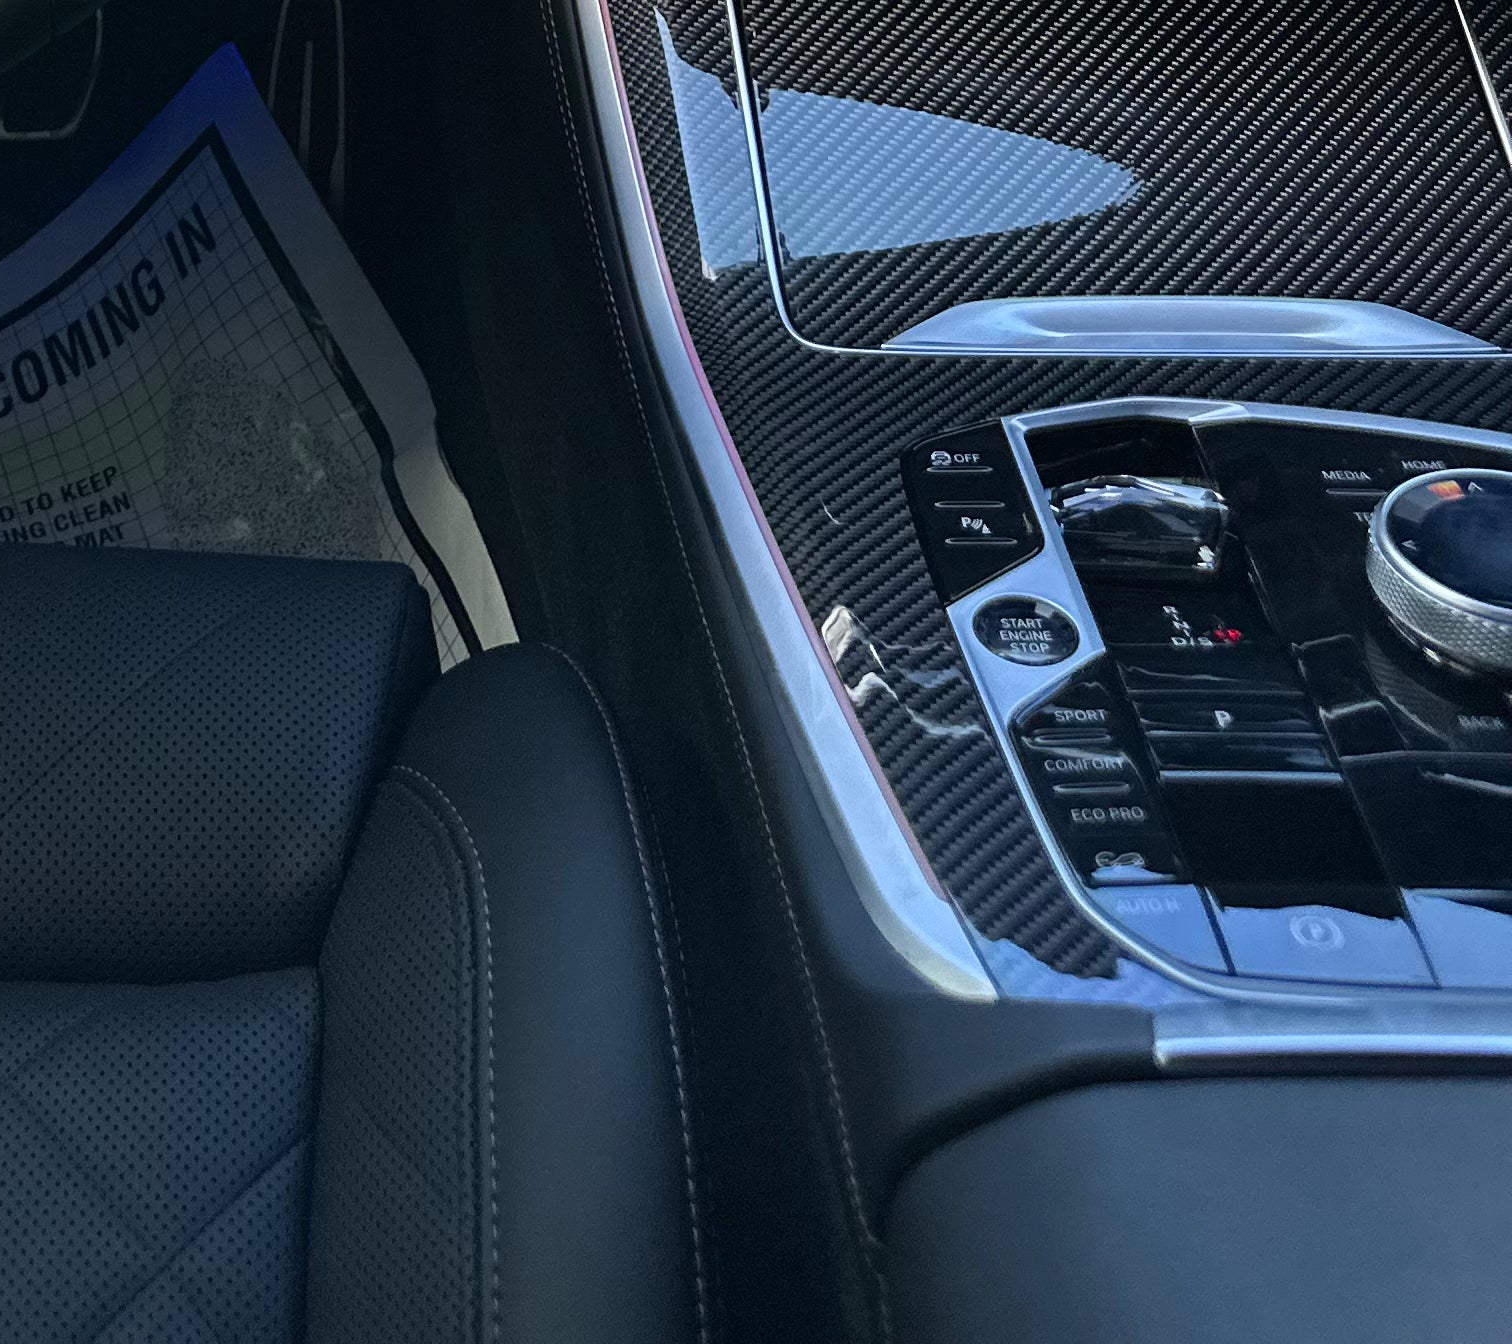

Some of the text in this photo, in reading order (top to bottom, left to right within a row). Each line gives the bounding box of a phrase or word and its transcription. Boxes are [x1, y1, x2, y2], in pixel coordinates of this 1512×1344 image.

[166, 202, 217, 279] IN
[953, 453, 980, 463] OFF
[1400, 460, 1445, 470] HOME
[1321, 470, 1372, 481] MEDIA
[20, 492, 55, 516] TO
[59, 465, 118, 503] KEEP
[53, 491, 132, 532] CLEAN
[74, 522, 125, 548] MAT
[1000, 618, 1042, 629] START
[999, 630, 1053, 641] ENGINE
[1009, 642, 1050, 653] STOP
[1054, 709, 1106, 722] SPORT
[1043, 758, 1127, 772] COMFORT
[1070, 806, 1144, 822] ECO PRO
